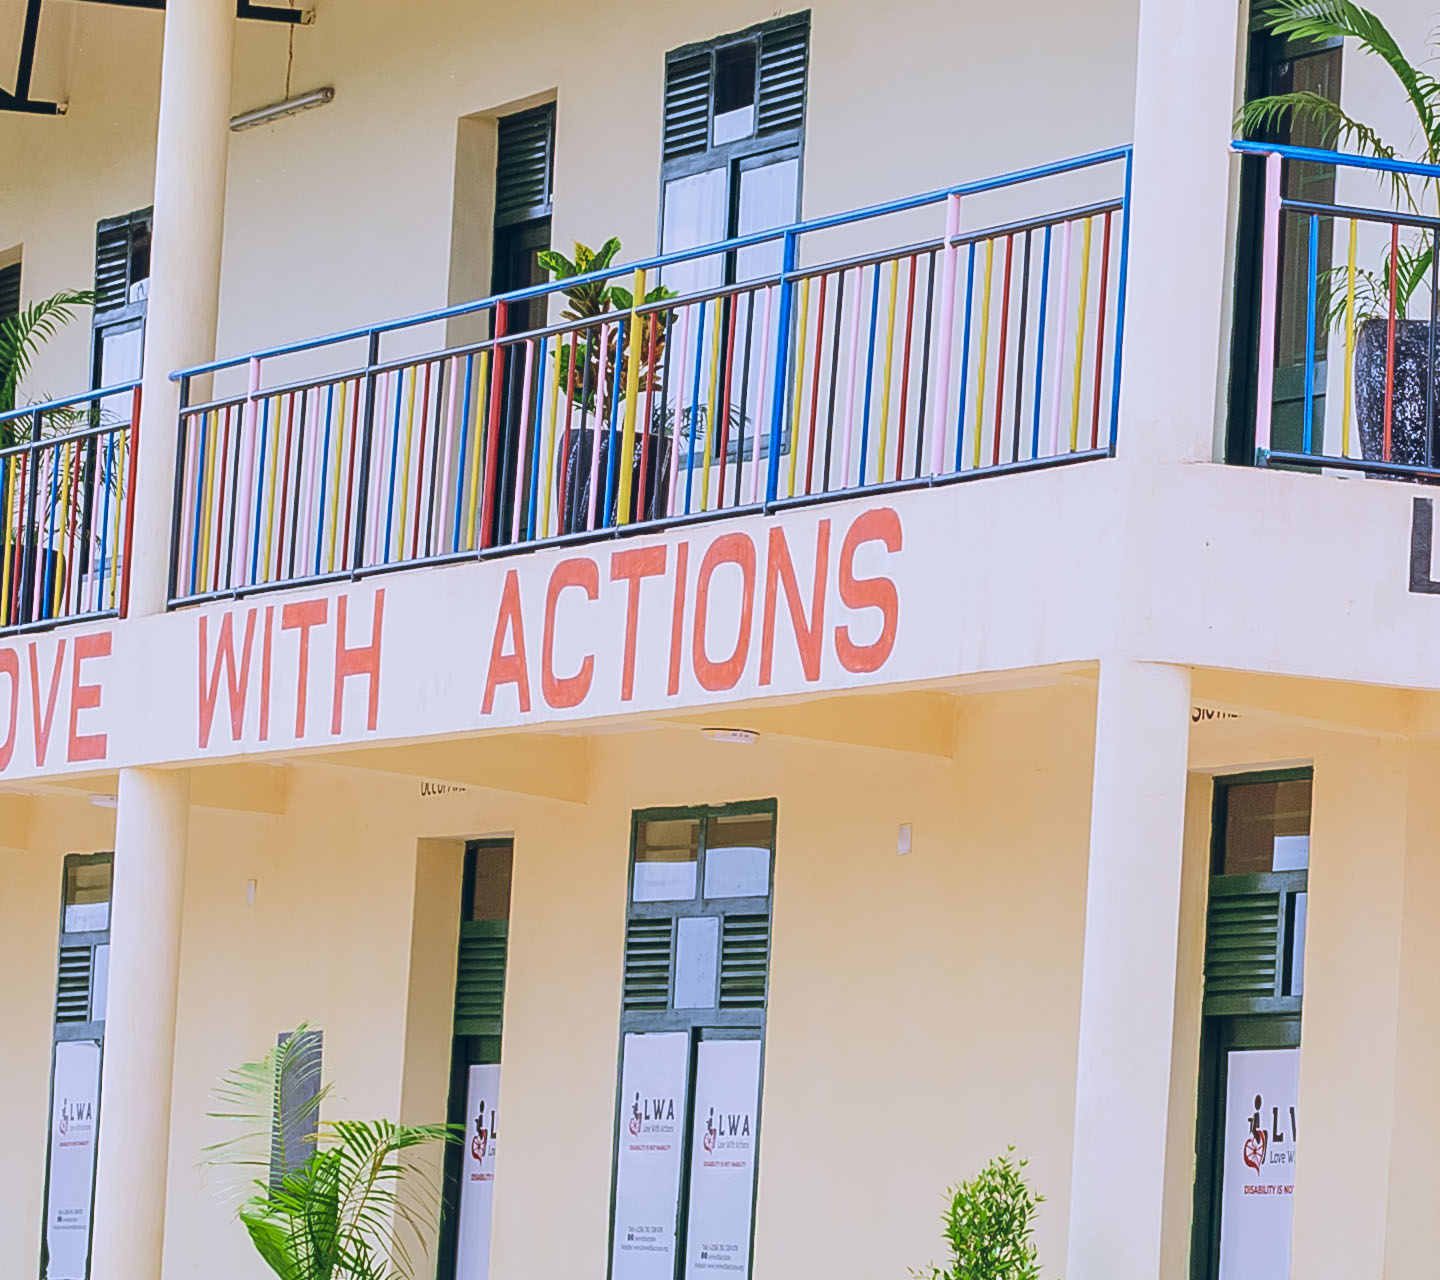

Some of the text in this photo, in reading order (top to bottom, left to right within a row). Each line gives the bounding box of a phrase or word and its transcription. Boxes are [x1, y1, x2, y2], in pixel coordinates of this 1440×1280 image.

[198, 589, 384, 749] WITH
[481, 508, 903, 715] ACTIONS
[70, 1102, 92, 1120] LWA
[644, 1099, 674, 1120] LWA
[719, 1114, 750, 1136] LWA
[1270, 1151, 1286, 1164] Love
[1244, 1184, 1275, 1195] DISABILITY
[1277, 1184, 1283, 1194] IS
